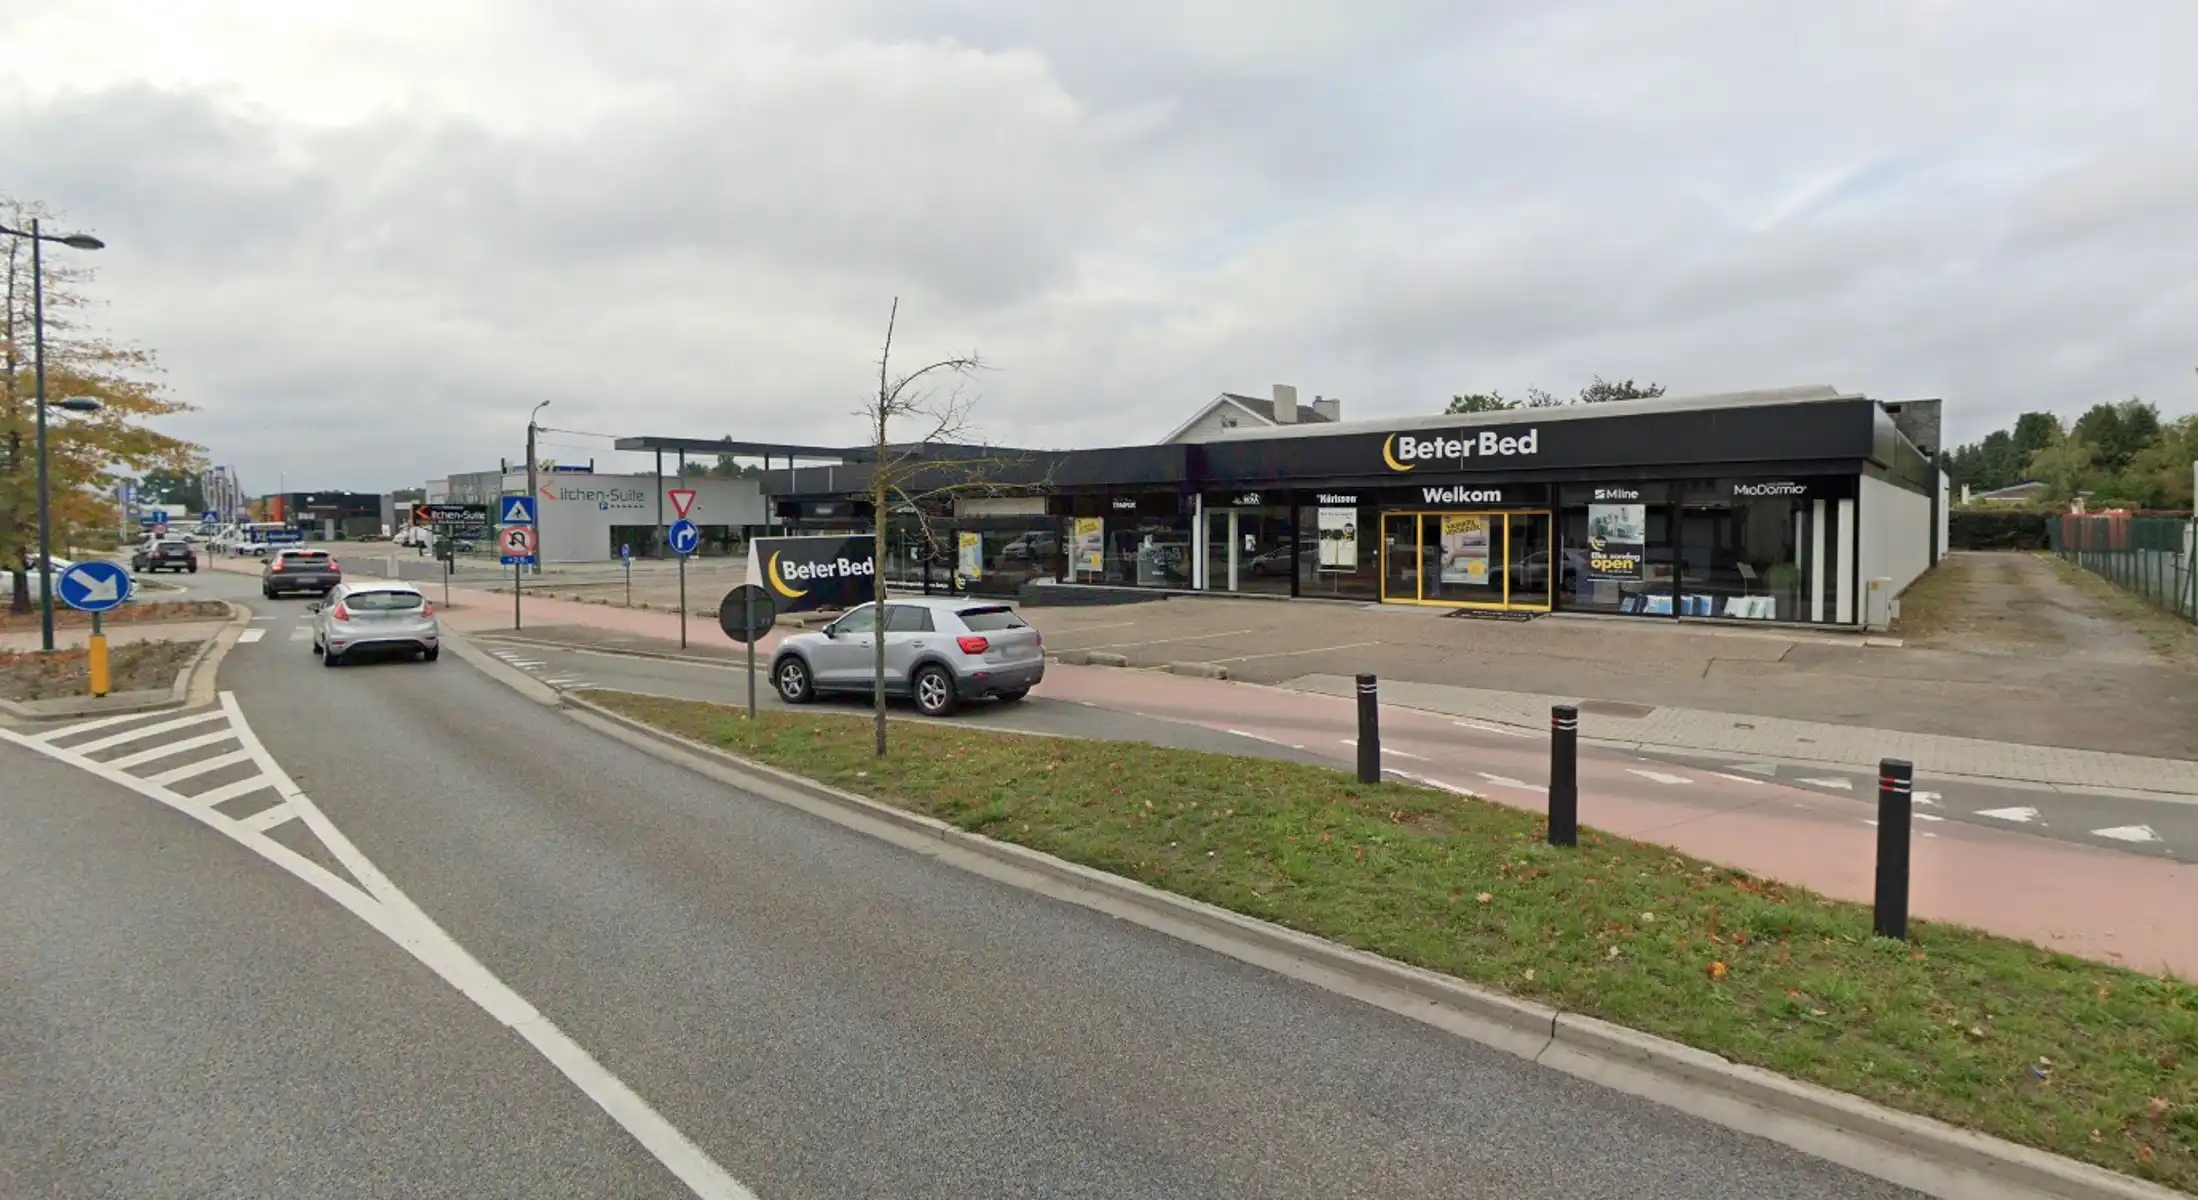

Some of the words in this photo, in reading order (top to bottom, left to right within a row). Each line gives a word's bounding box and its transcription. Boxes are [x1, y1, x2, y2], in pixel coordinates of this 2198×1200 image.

[1398, 436, 1477, 461] Beter
[1478, 428, 1538, 456] Bed
[1422, 485, 1502, 504] Welkom
[781, 558, 835, 581] Beter
[834, 556, 874, 578] Bed
[1590, 559, 1634, 574] open
